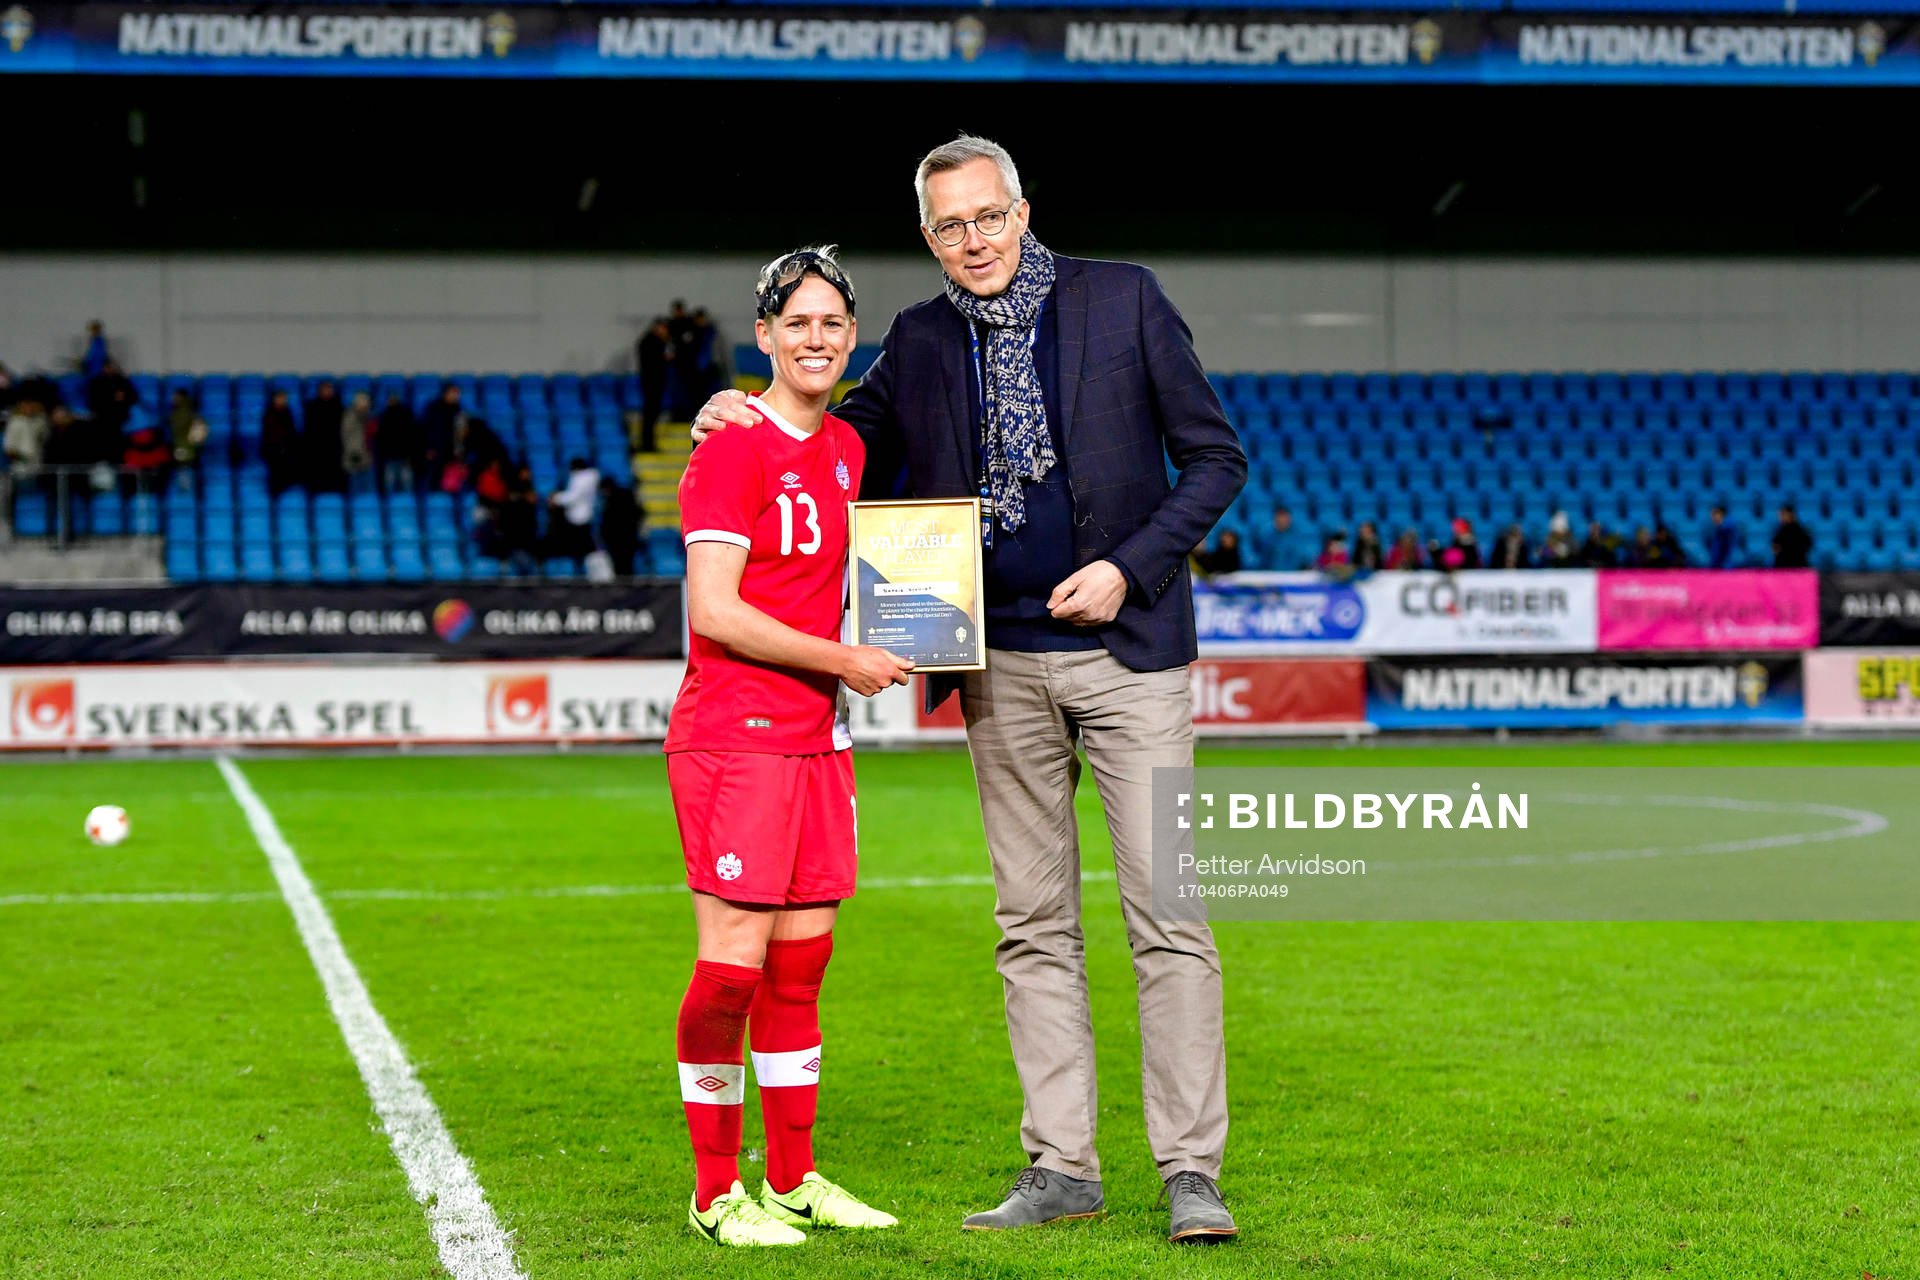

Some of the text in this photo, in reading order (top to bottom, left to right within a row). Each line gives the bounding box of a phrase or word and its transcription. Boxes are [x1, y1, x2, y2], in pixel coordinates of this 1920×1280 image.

[118, 14, 482, 57] NATIONALSPORTEN
[599, 17, 950, 60] NATIONALSPORTEN
[1065, 22, 1409, 64] NATIONALSPORTEN
[1518, 26, 1853, 67] NATIONALSPORTEN
[775, 492, 822, 556] 13
[869, 533, 962, 549] VALUABLE
[1402, 667, 1737, 710] NATIONALSPORTEN
[87, 701, 422, 736] SVENSKA SPEL
